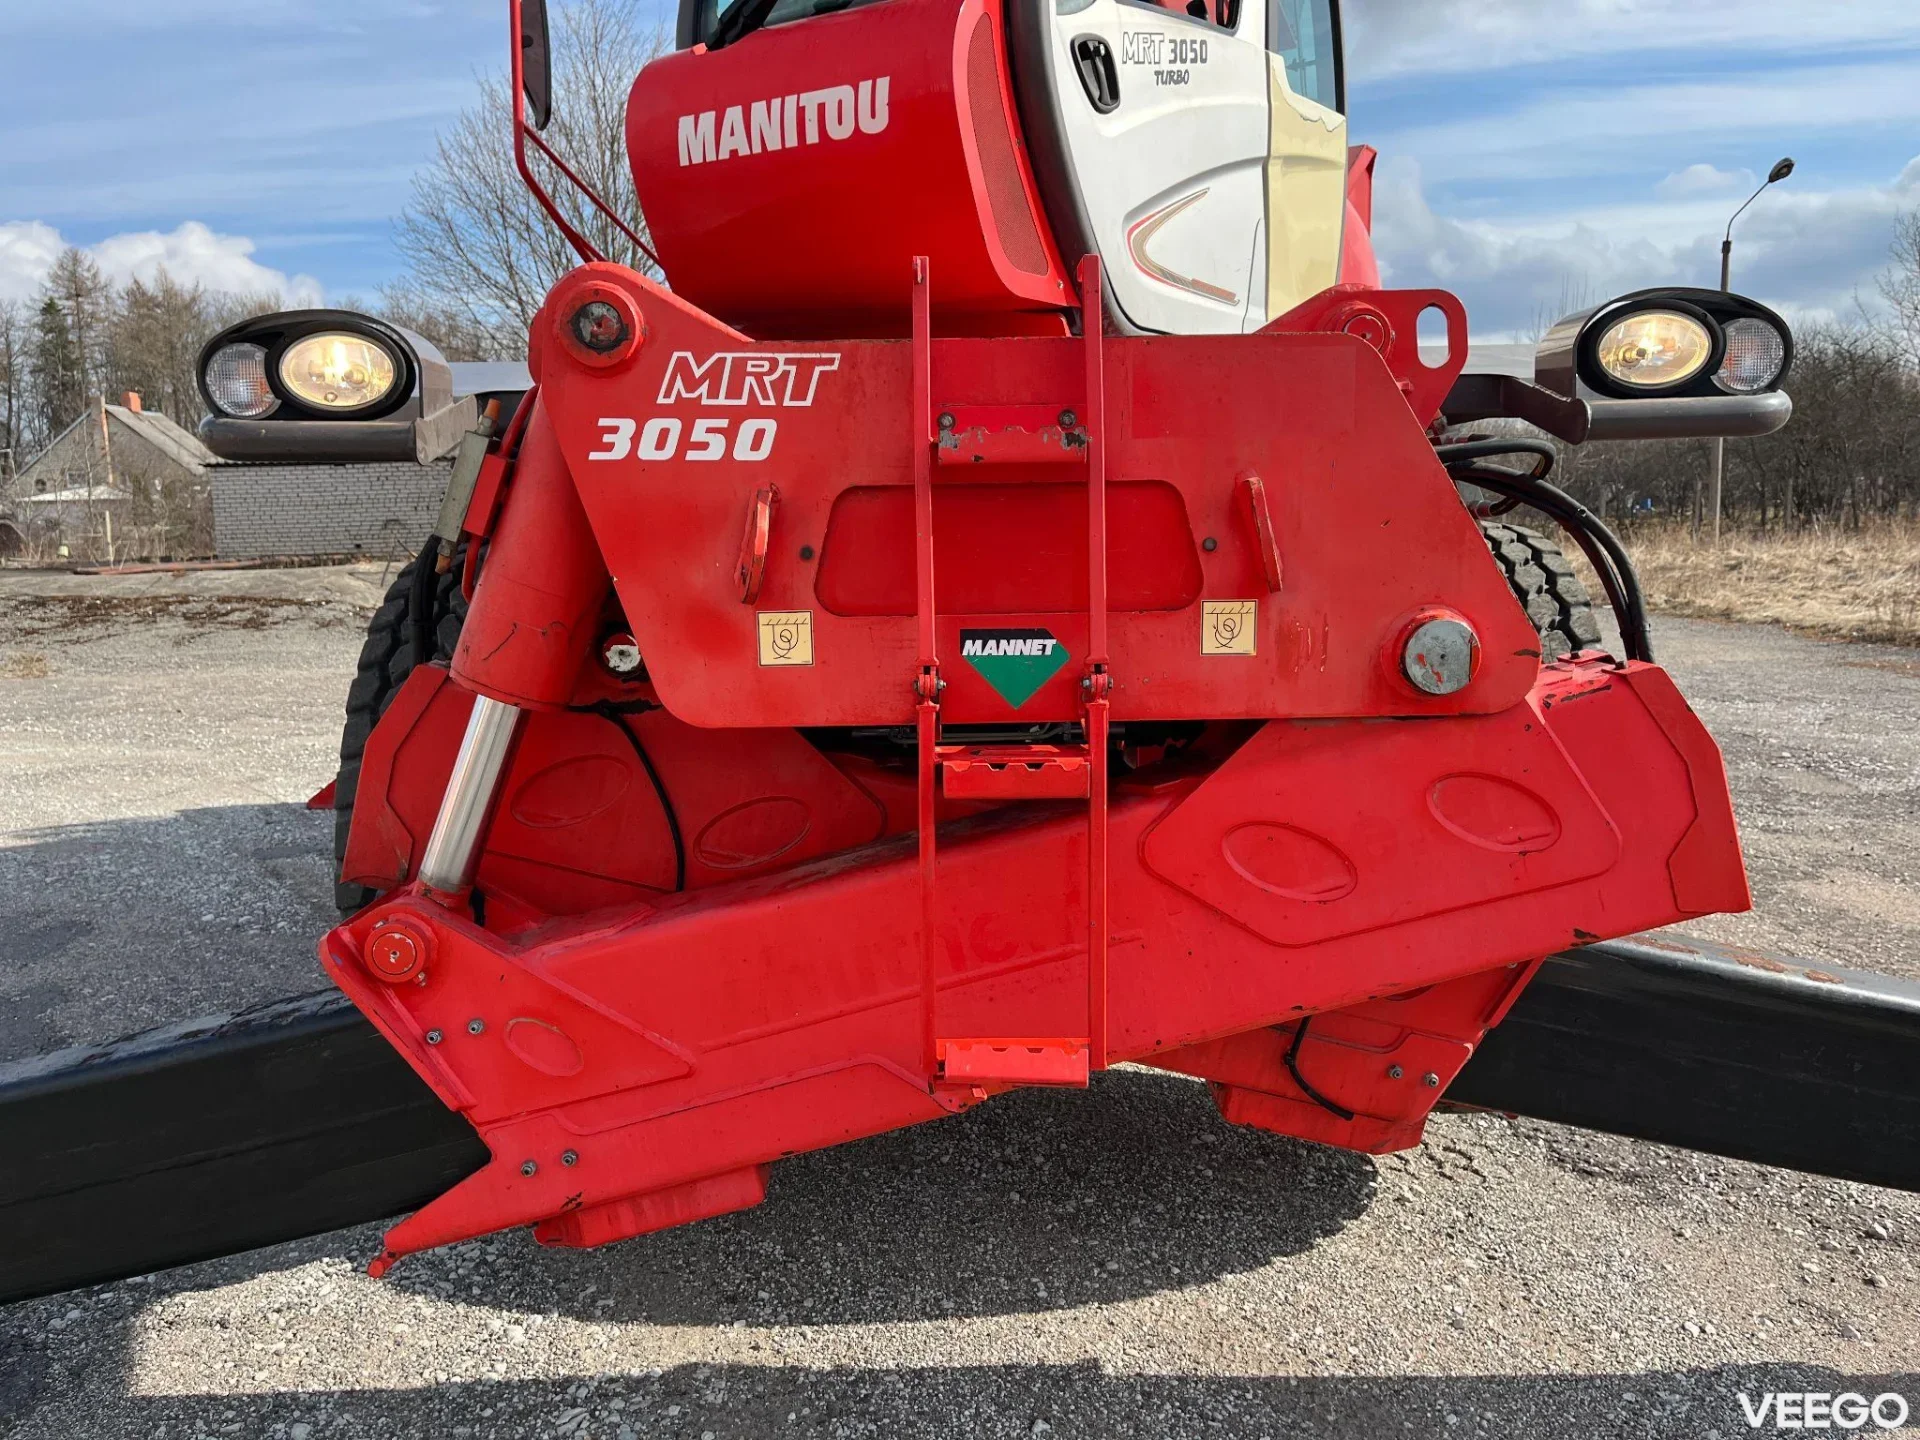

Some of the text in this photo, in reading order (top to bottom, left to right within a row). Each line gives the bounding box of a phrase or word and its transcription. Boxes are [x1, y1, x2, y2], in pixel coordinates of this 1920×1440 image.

[1122, 31, 1208, 65] MRT 3050
[1154, 69, 1190, 86] TURBO
[678, 76, 890, 167] MANITOU
[656, 351, 841, 407] MRT
[588, 418, 777, 461] 3050
[962, 638, 1057, 656] MANNET
